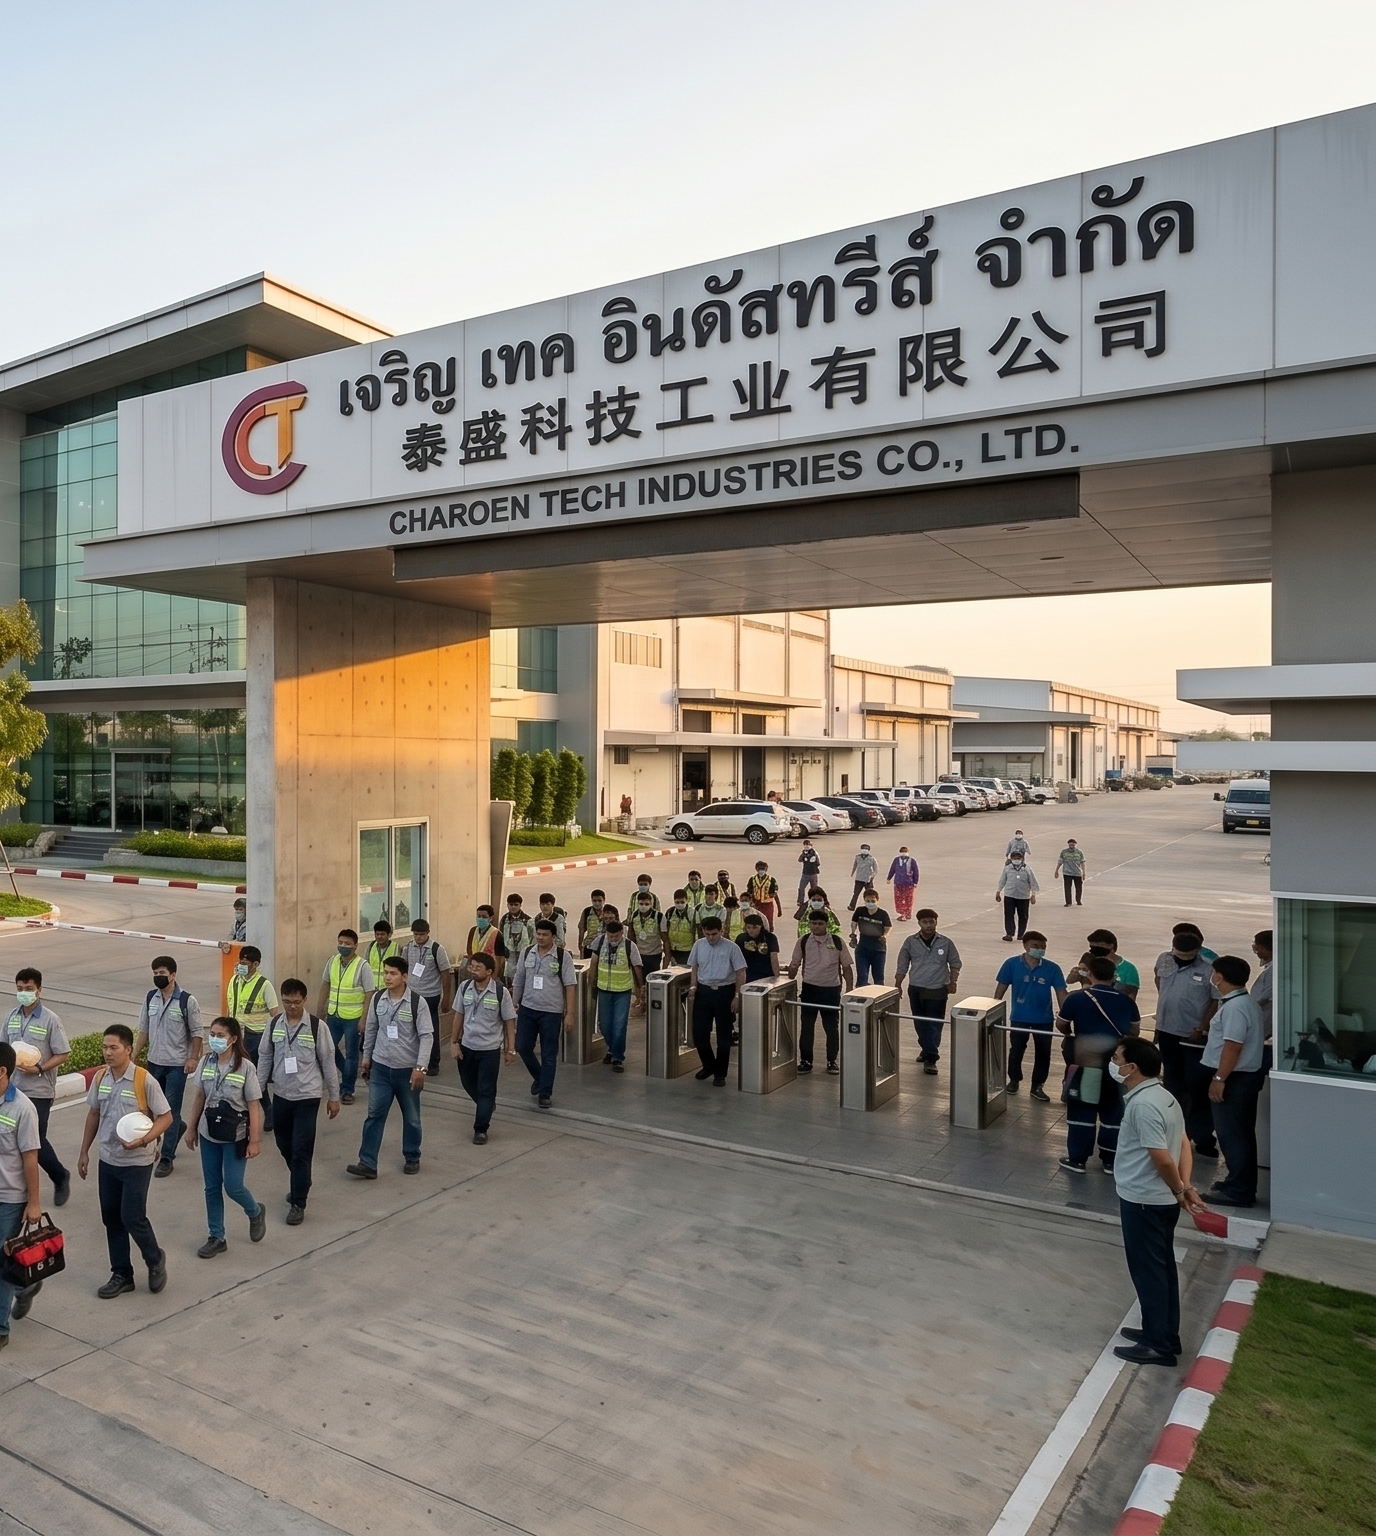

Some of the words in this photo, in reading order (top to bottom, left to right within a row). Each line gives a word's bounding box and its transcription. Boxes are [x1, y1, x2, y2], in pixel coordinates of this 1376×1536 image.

[339, 349, 456, 416] เจริญ
[481, 332, 575, 389] เทค
[601, 214, 939, 364] อินดัสทรีส์
[974, 175, 1195, 288] จำกัด
[401, 289, 1167, 473] 泰盛科技工业有限公司
[389, 493, 530, 535] CHAROEN
[539, 481, 626, 517] TECH
[638, 450, 863, 506] INDUSTRIES
[876, 440, 963, 476] CO.,
[981, 423, 1080, 464] LTD.
